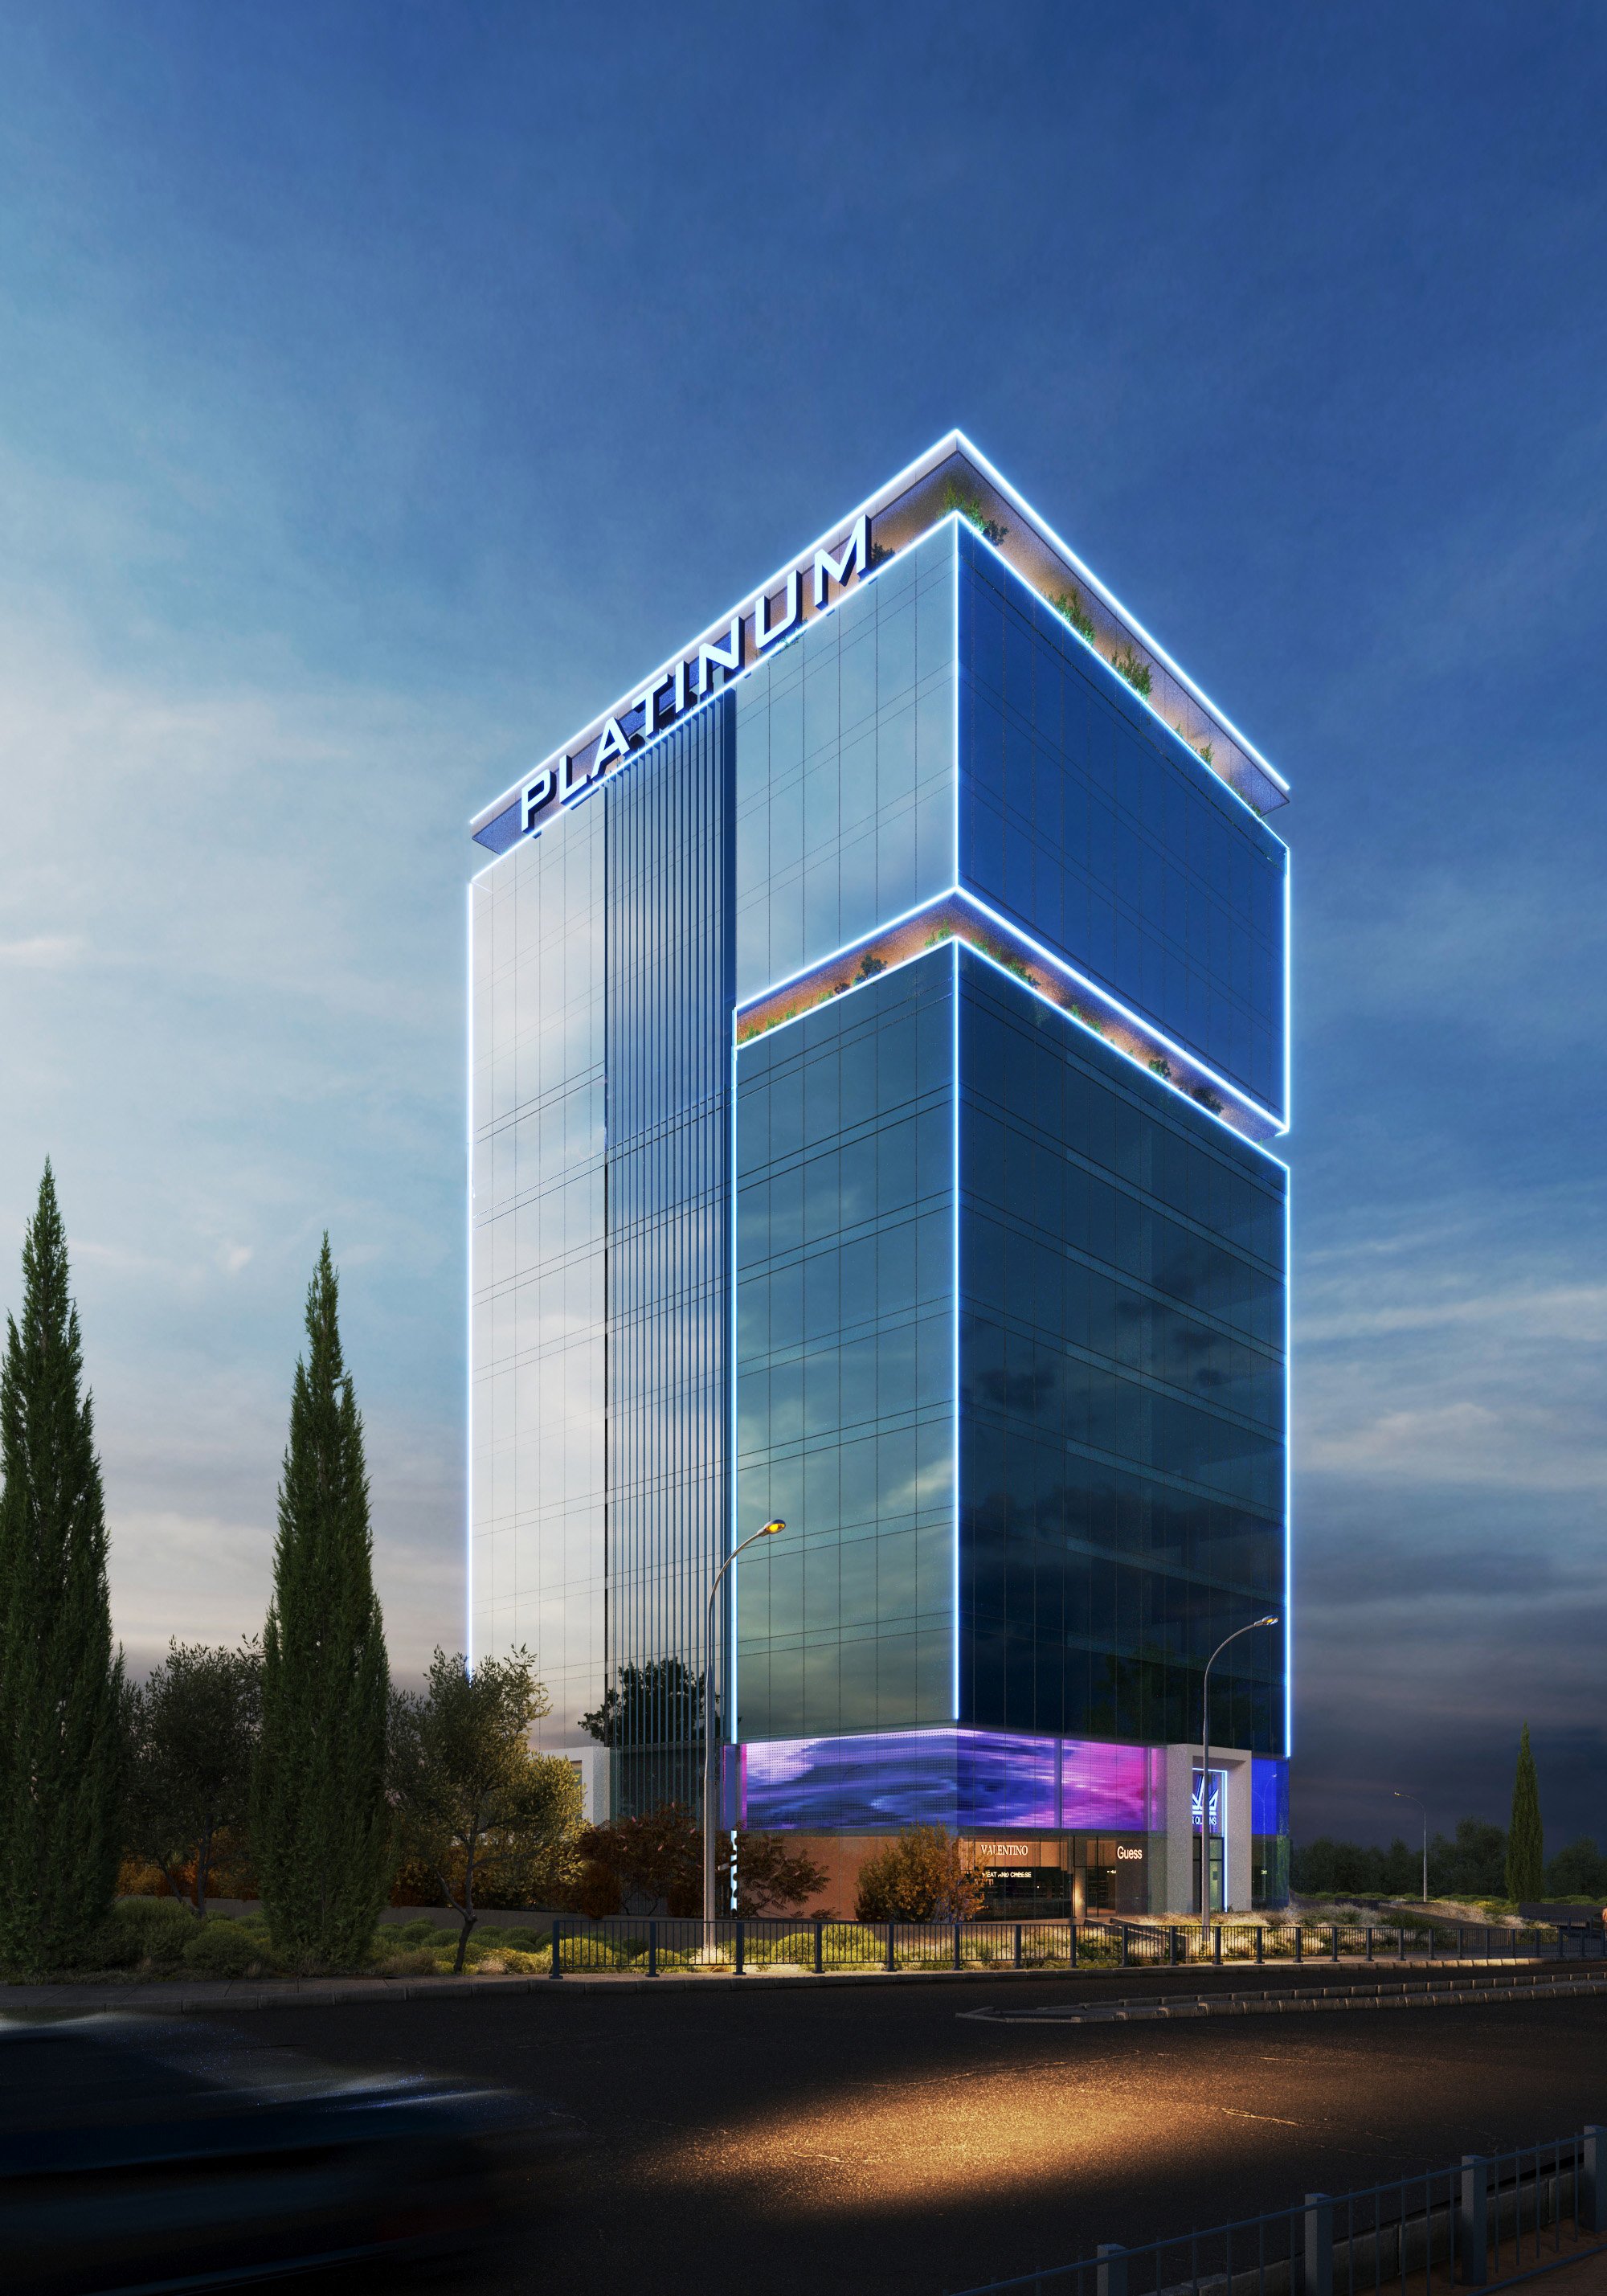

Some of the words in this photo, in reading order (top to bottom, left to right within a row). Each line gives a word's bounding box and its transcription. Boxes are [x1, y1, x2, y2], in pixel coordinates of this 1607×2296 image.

[521, 514, 868, 833] PLATINUM
[1195, 1816, 1217, 1825] QUNS
[981, 1844, 1028, 1856] VALENTINO
[1117, 1845, 1143, 1860] Guess
